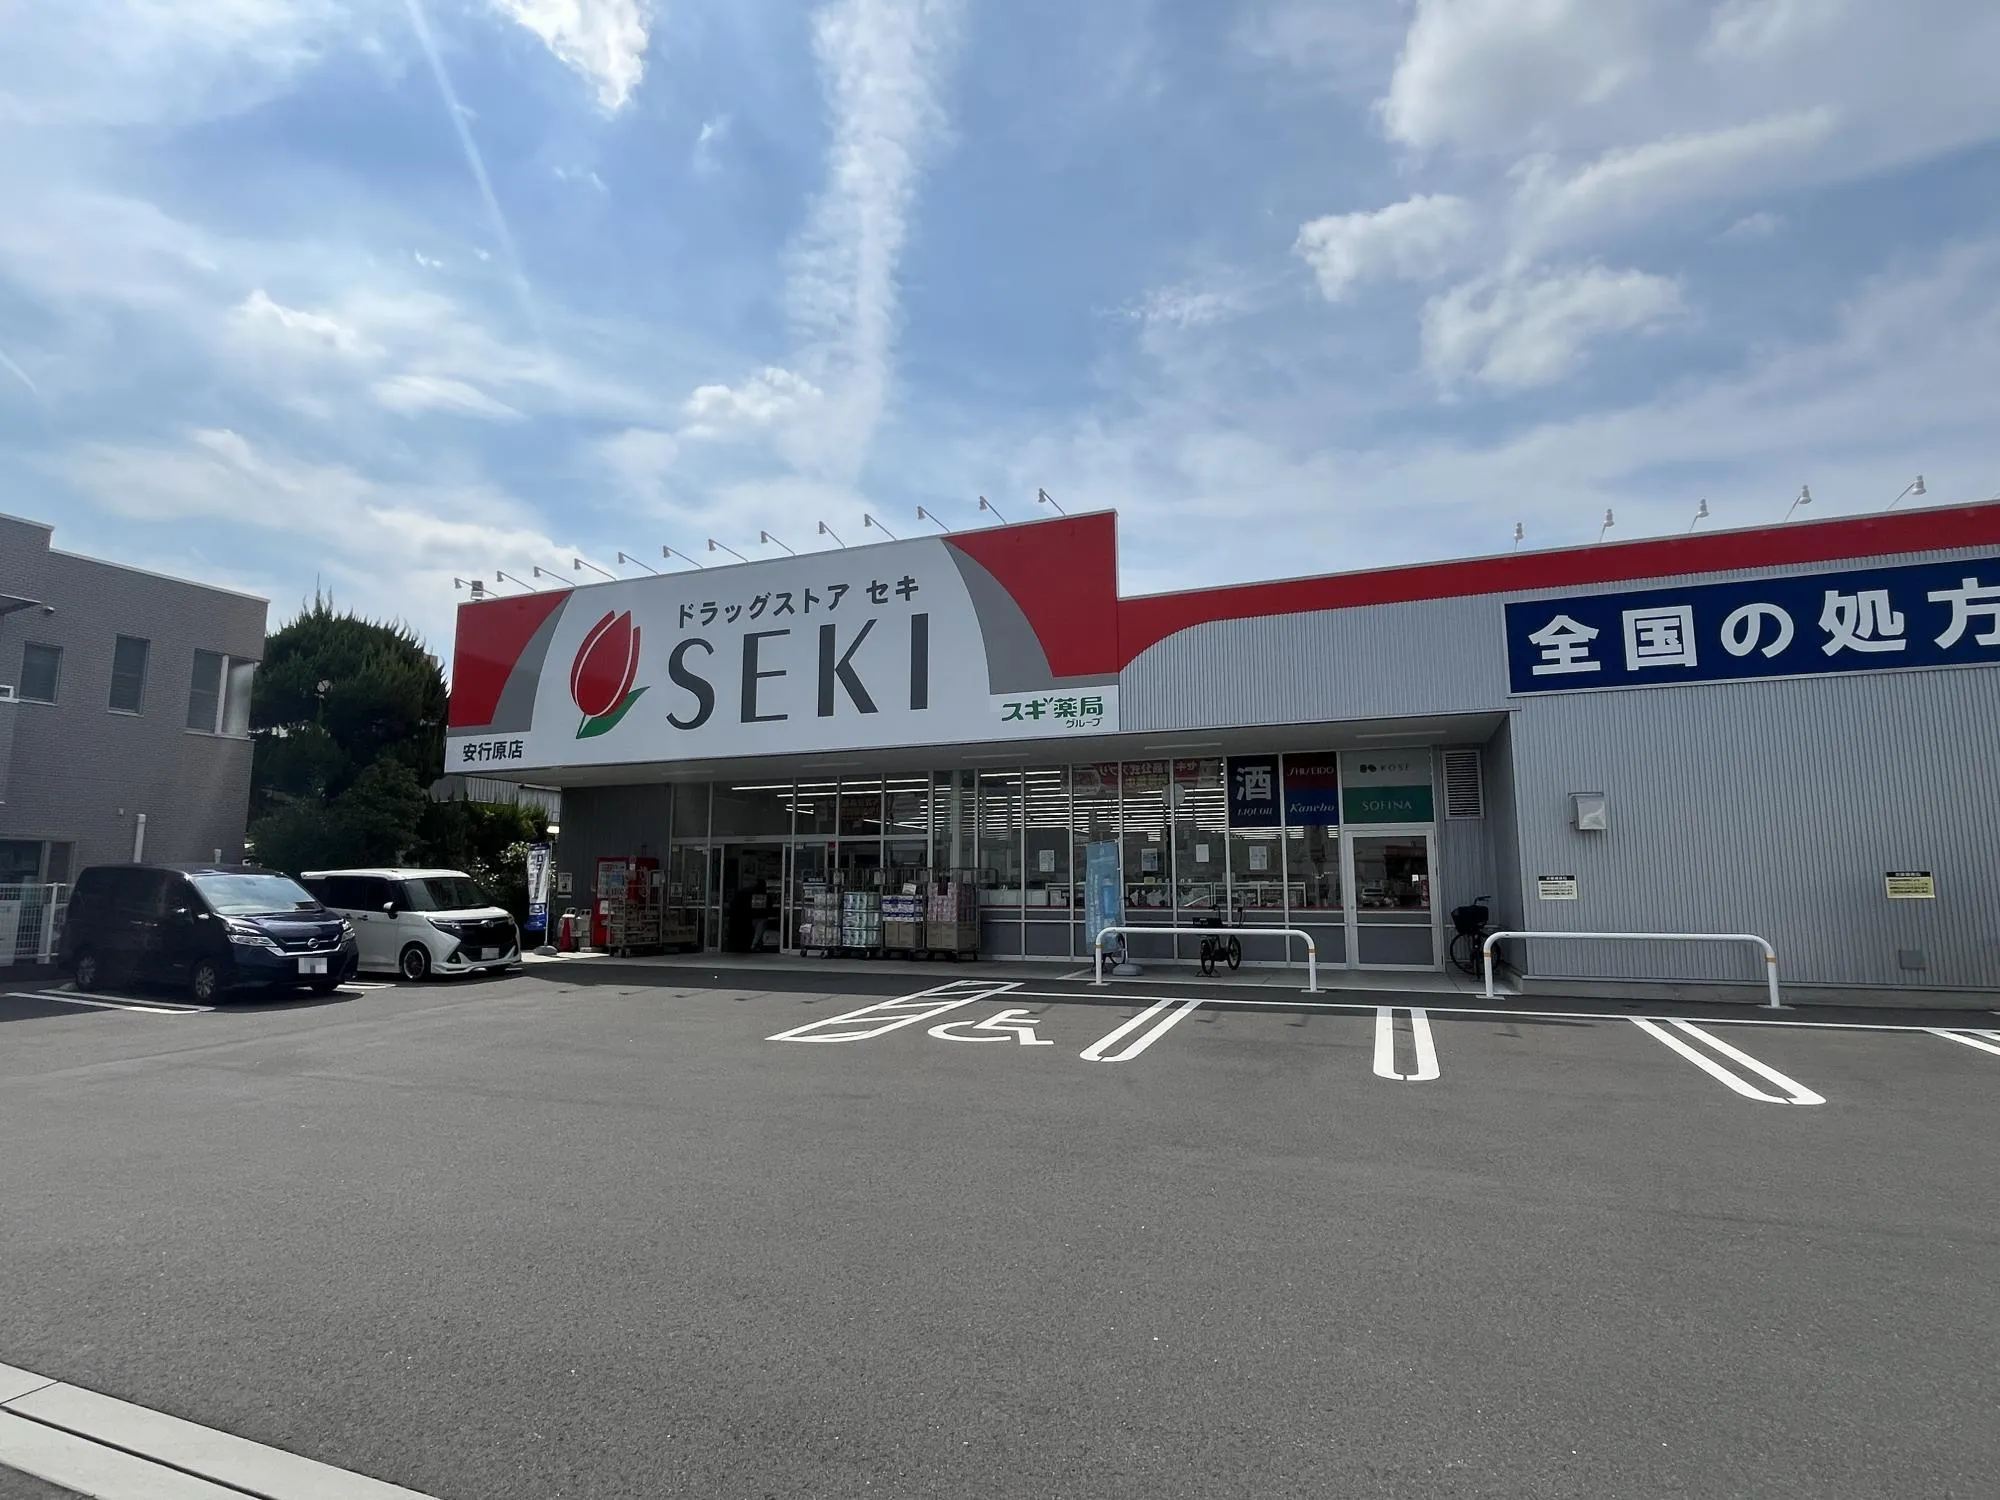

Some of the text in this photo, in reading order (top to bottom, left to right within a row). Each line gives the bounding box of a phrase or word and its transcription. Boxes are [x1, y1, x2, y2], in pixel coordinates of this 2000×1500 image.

[679, 575, 919, 629] ドラッグストア セキ
[1528, 577, 2000, 676] 全国の処方
[666, 612, 929, 730] SEKI
[1002, 696, 1104, 721] スギ薬局
[1065, 717, 1103, 728] グループ
[463, 740, 524, 762] 安行原店
[1236, 765, 1272, 801] 酒
[1289, 802, 1335, 813] Kanebo
[1362, 799, 1412, 812] SOFINA
